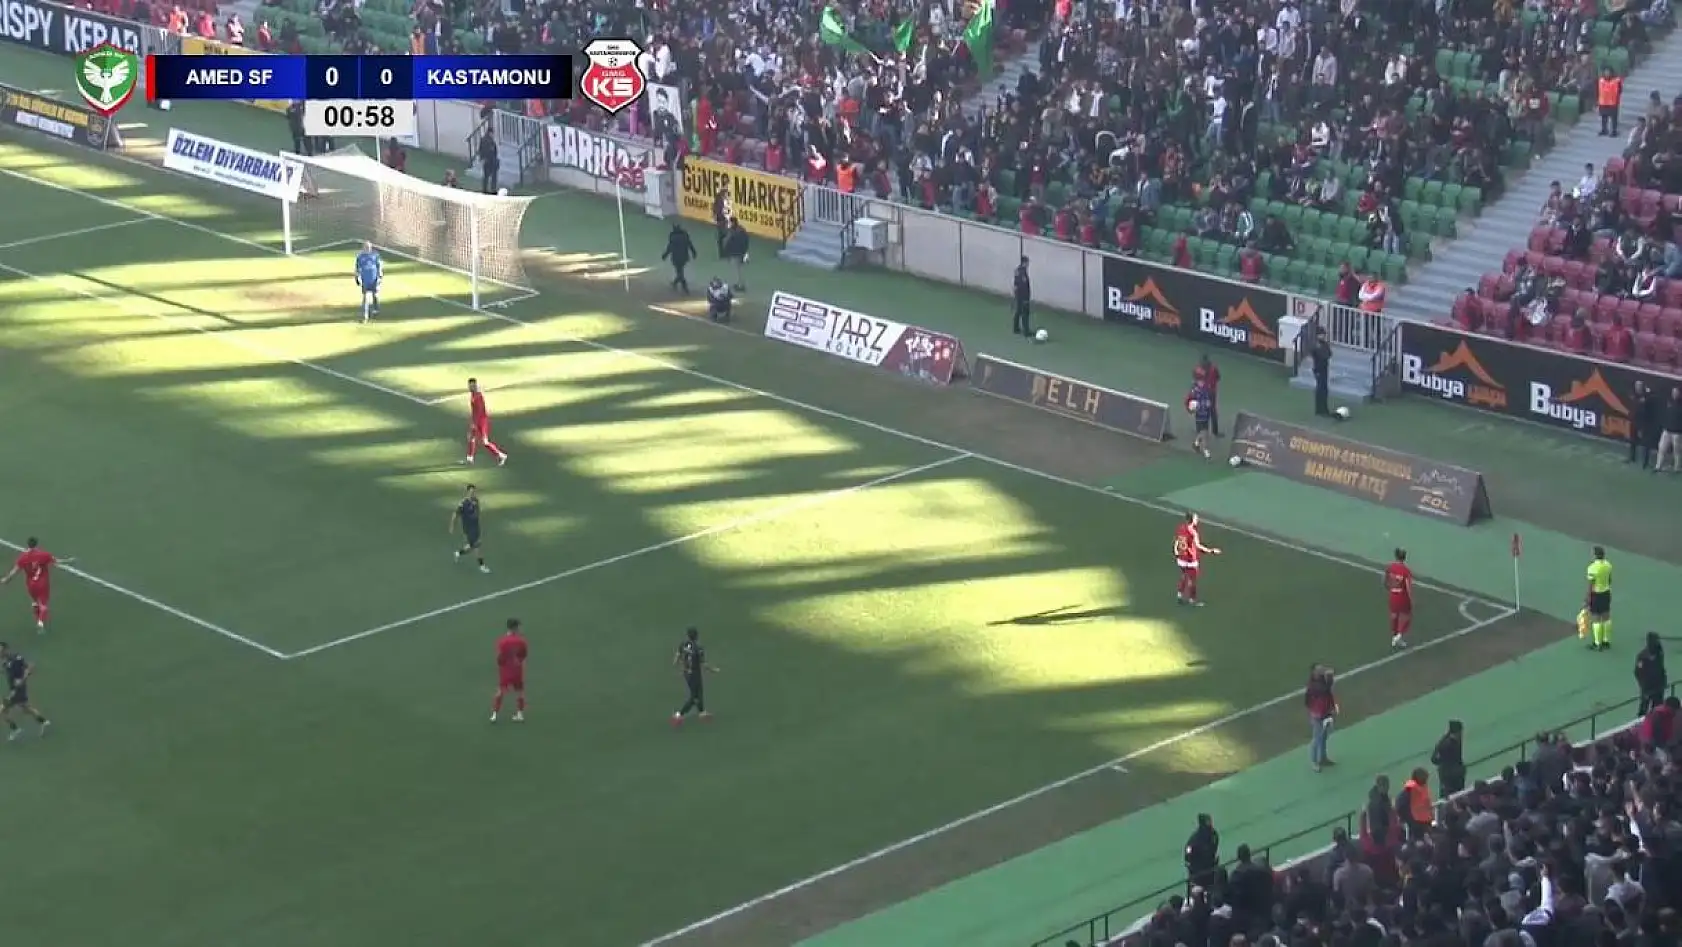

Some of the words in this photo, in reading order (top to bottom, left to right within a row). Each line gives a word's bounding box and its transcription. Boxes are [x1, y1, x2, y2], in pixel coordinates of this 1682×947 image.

[734, 176, 796, 217] MARKET
[1108, 286, 1151, 320] Bubya
[830, 310, 888, 352] TARZ
[1200, 308, 1246, 343] Bubya
[1402, 353, 1464, 398] Bubya
[1530, 381, 1597, 429] Bubya
